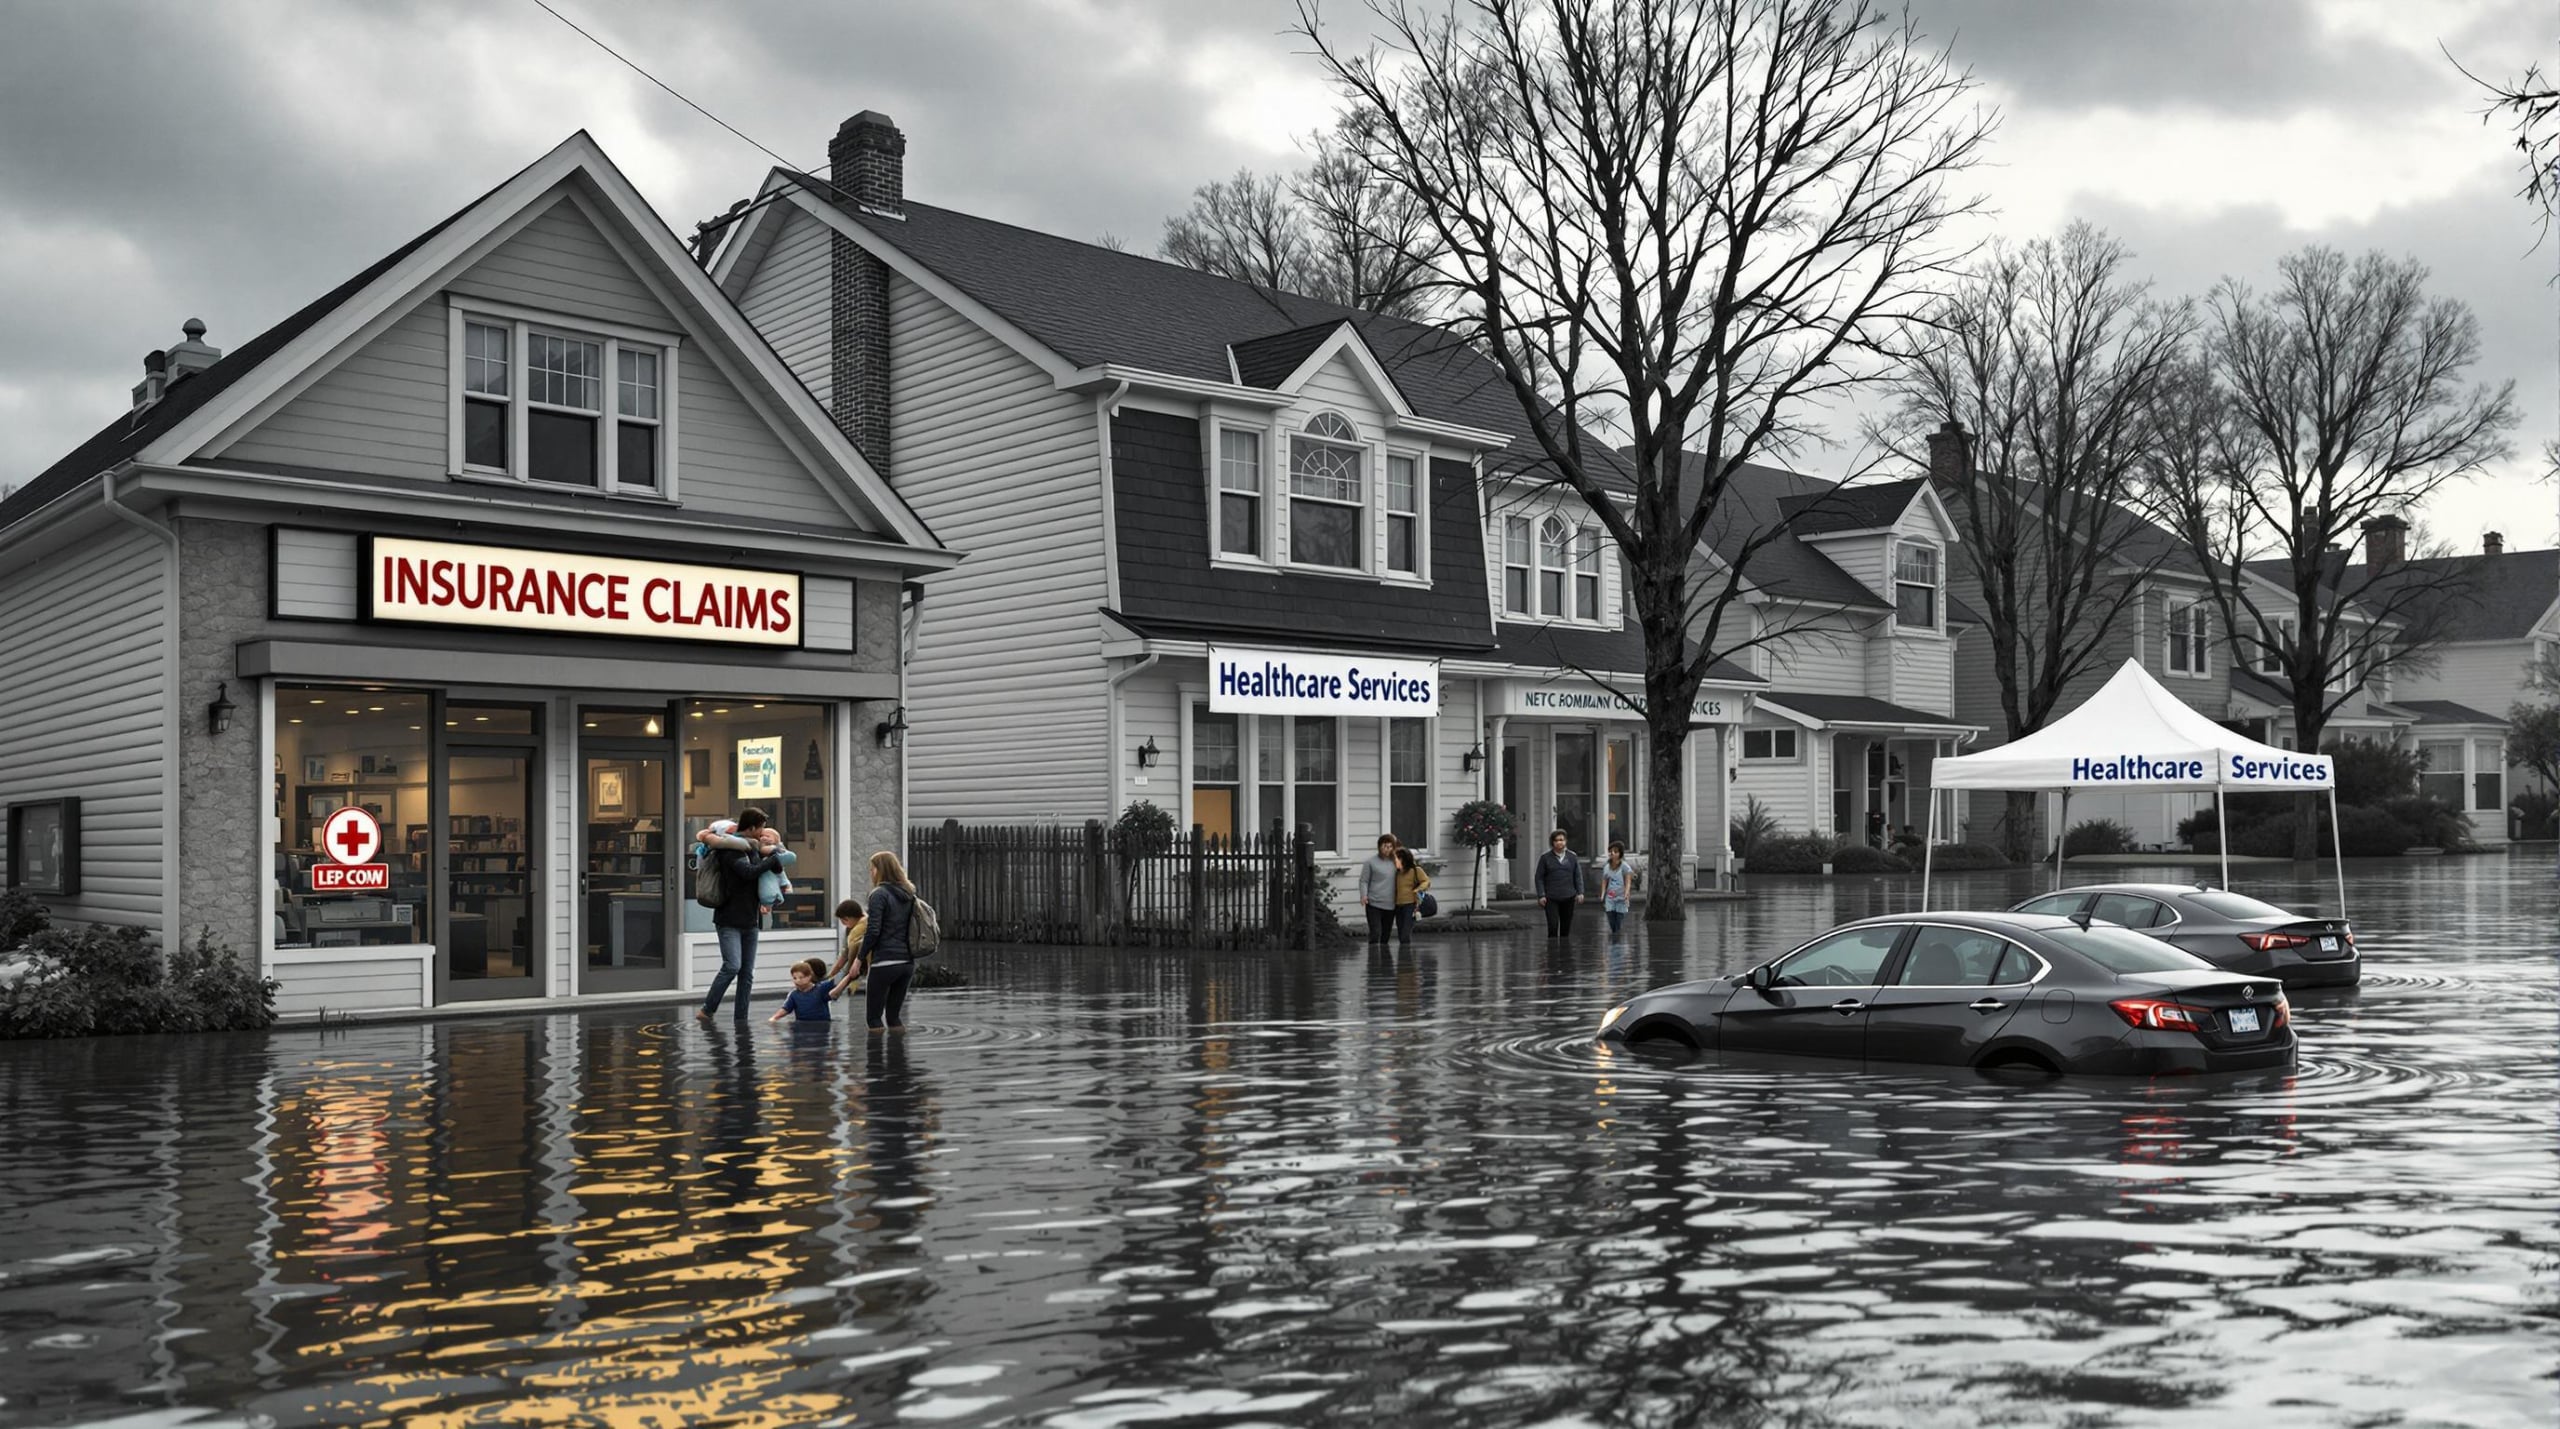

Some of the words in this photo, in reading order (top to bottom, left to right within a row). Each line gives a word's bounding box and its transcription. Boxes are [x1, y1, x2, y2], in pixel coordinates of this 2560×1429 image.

[384, 557, 629, 619] INSURANCE
[642, 578, 791, 632] CLAIMS
[1219, 661, 1341, 698] Healthcare
[1348, 668, 1431, 703] Services
[2072, 755, 2203, 780] Healthcare
[2231, 755, 2327, 780] Services
[318, 869, 344, 886] LEP
